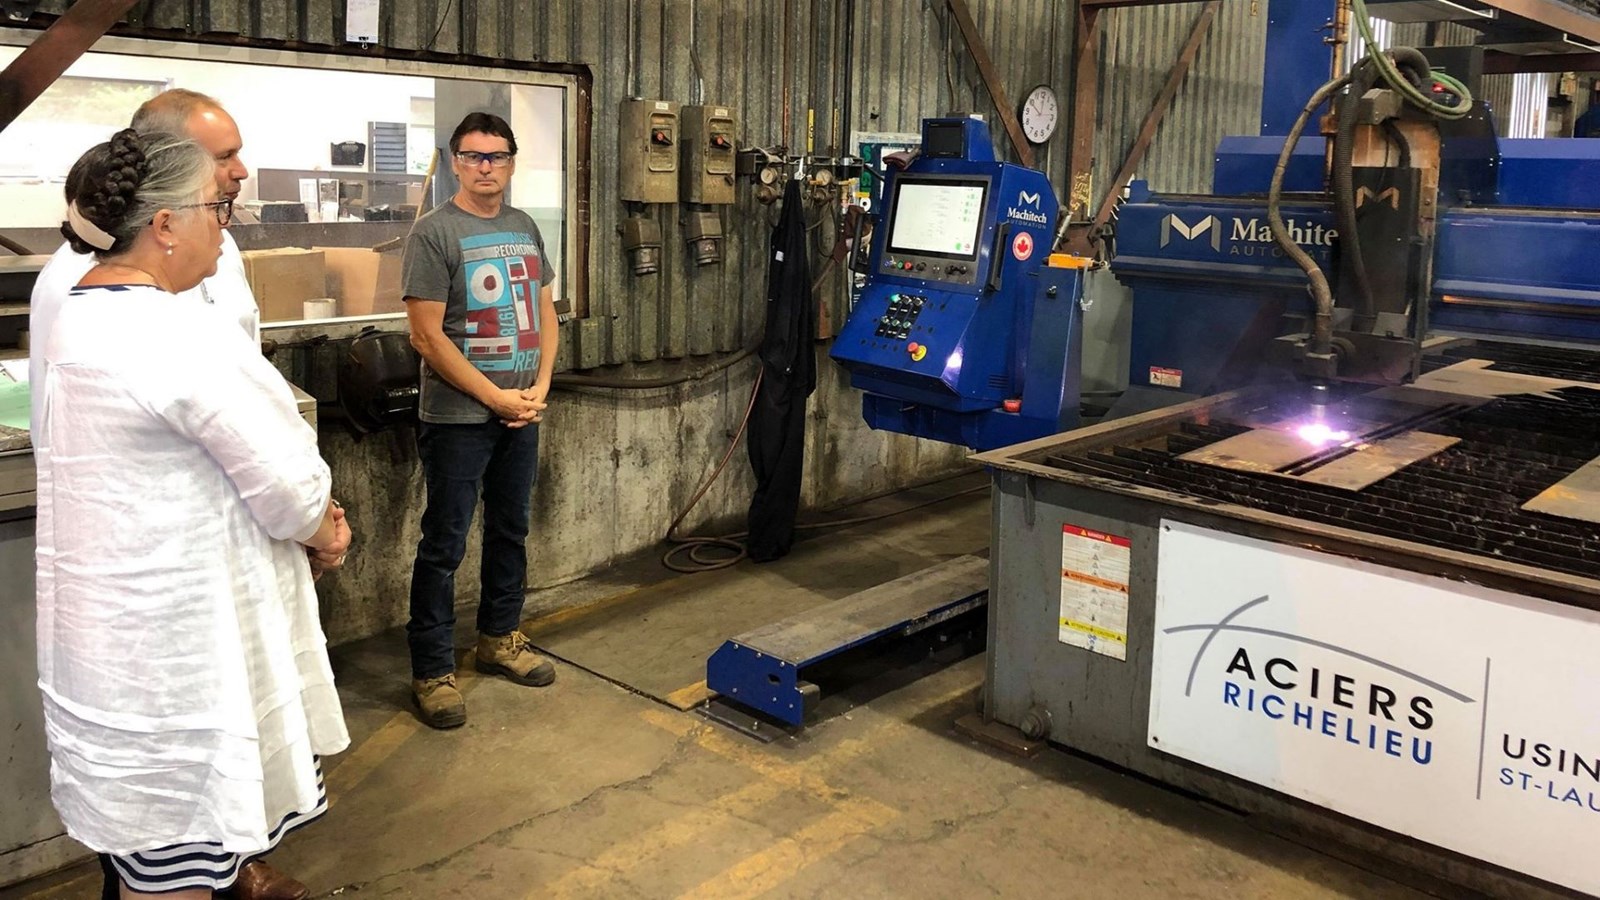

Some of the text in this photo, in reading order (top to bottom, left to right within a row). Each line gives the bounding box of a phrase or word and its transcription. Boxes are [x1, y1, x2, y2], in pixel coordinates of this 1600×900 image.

[1007, 206, 1047, 224] Machitech
[1230, 217, 1340, 247] Mahite
[495, 243, 538, 258] RECORDING
[497, 305, 518, 337] 1978
[1226, 647, 1434, 731] ACIERS
[1223, 681, 1432, 765] RICHELIEU
[1502, 733, 1600, 783] USIN
